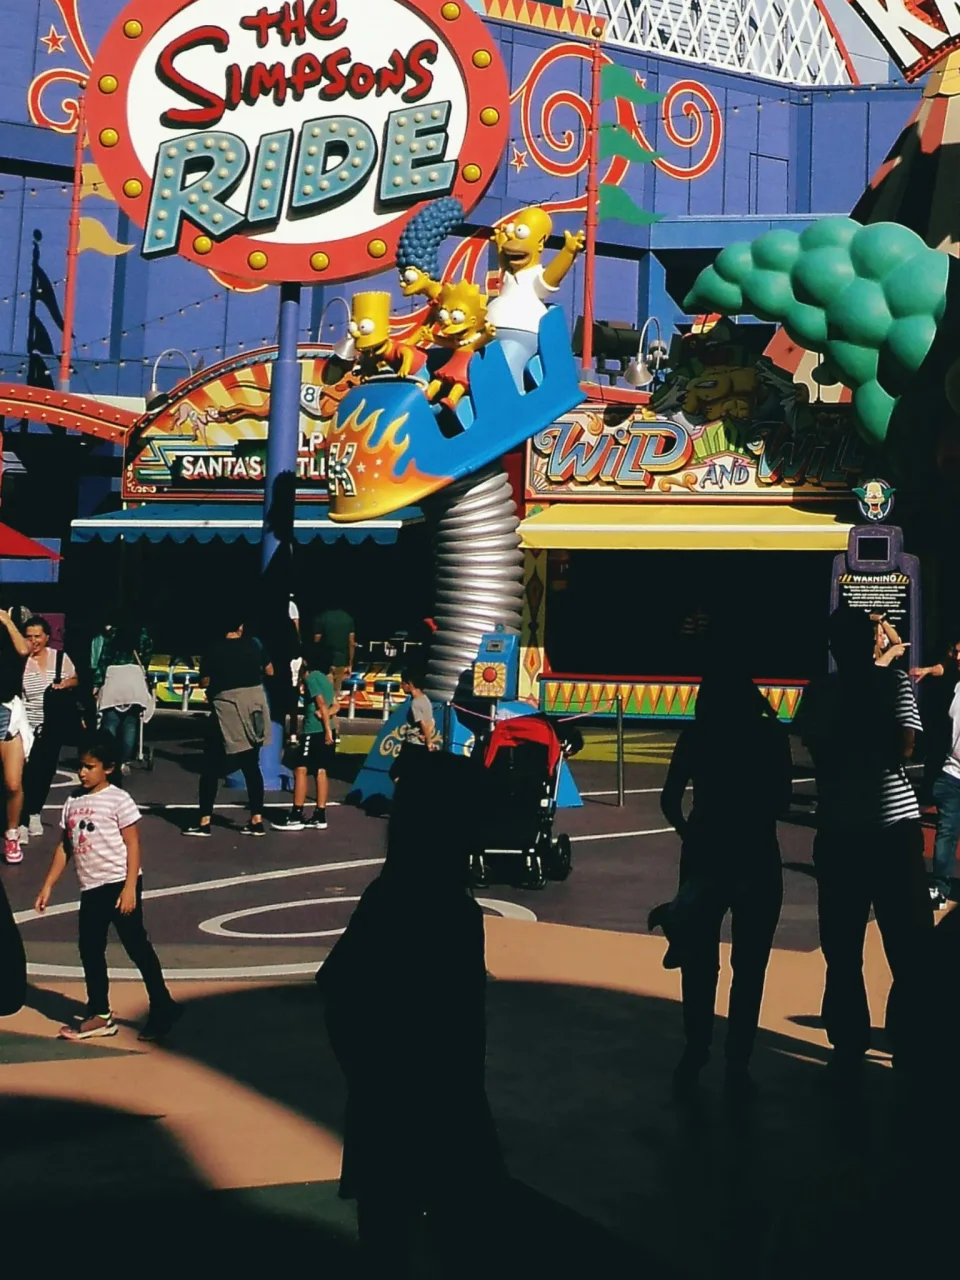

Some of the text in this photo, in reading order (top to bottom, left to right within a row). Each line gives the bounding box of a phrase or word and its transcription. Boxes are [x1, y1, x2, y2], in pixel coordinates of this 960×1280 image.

[141, 101, 457, 260] RIDE
[304, 386, 316, 403] 8
[181, 455, 261, 479] SANTA'S
[328, 442, 358, 497] K
[700, 457, 750, 489] AND
